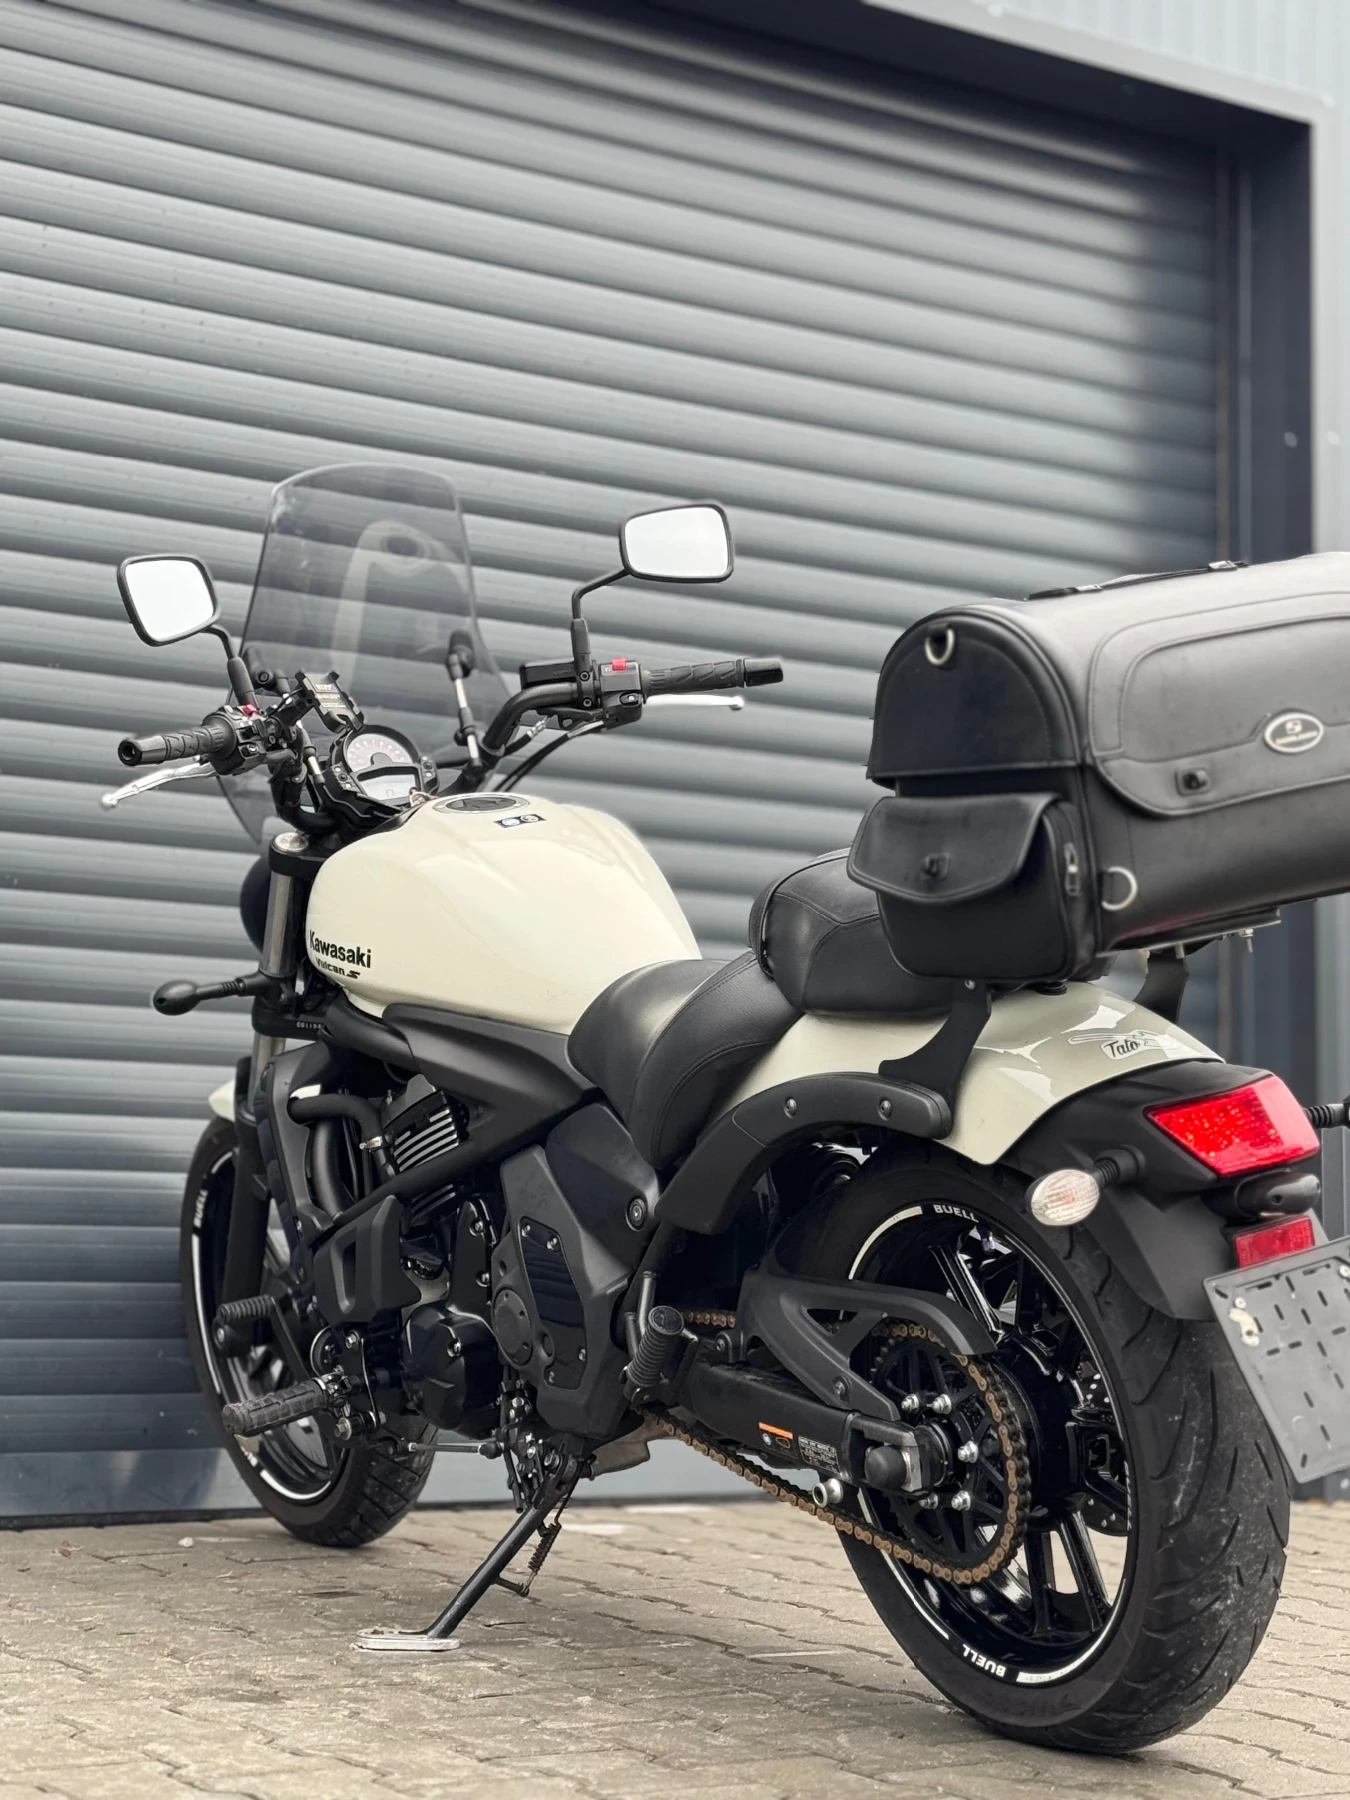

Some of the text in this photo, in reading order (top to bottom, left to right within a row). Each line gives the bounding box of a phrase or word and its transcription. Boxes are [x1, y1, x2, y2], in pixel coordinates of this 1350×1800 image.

[310, 929, 371, 968] Kawasaki
[315, 957, 361, 980] Vulcan S
[193, 1189, 208, 1228] BUELL
[933, 1204, 979, 1223] BUELL
[962, 1643, 1007, 1678] BUELL
